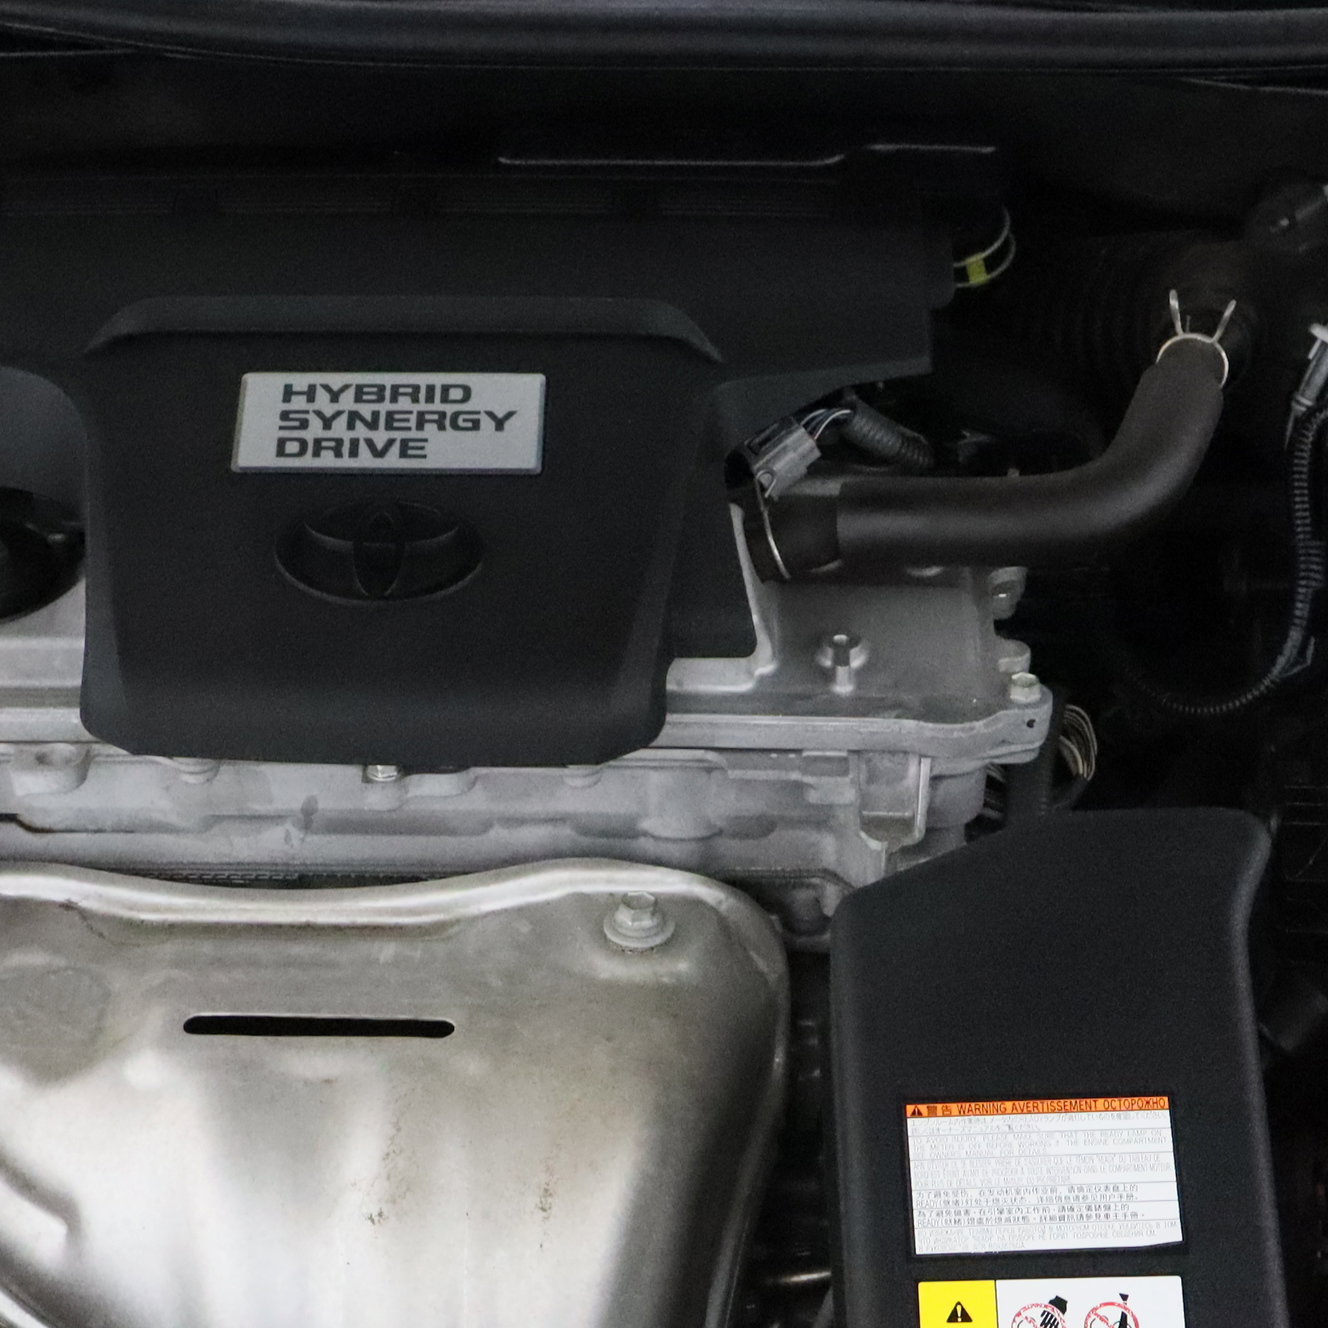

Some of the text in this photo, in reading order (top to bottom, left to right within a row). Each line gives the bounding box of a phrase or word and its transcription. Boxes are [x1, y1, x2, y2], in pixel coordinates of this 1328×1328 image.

[281, 383, 472, 404] HYBRID
[278, 409, 518, 432] SYNERGY
[275, 437, 429, 459] DRIVE
[957, 1099, 1098, 1115] WARNING AVERTISSEMENT
[1103, 1097, 1166, 1110] ОСТОРОЖНО
